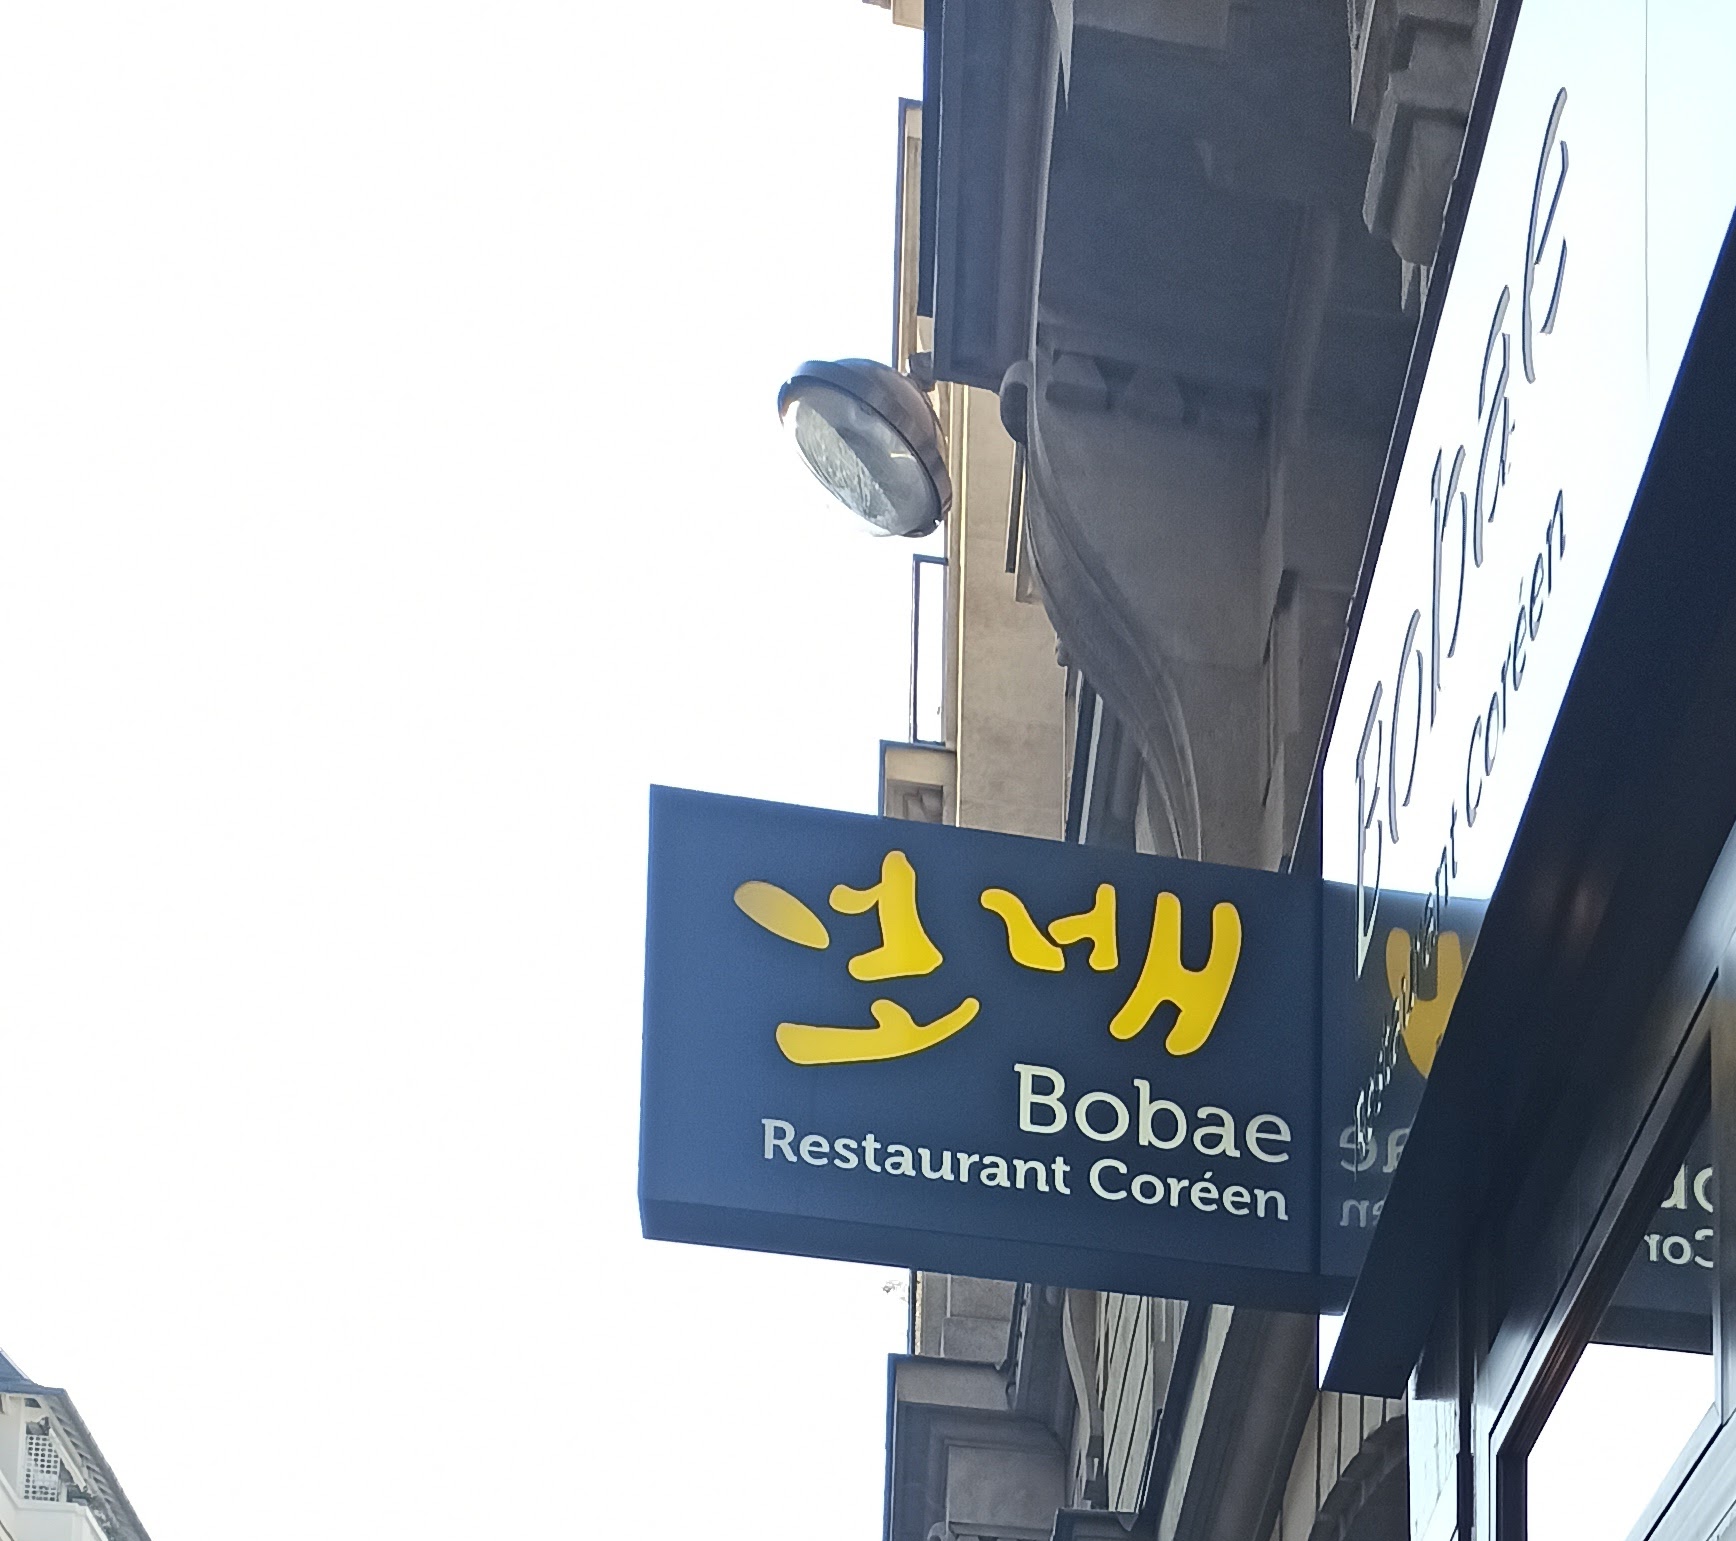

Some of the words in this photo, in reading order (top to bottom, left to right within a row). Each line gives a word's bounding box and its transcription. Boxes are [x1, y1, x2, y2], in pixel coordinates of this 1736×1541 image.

[1014, 1063, 1292, 1164] Bobae
[761, 1118, 1071, 1195] Restaurant
[1089, 1160, 1289, 1222] Coréen
